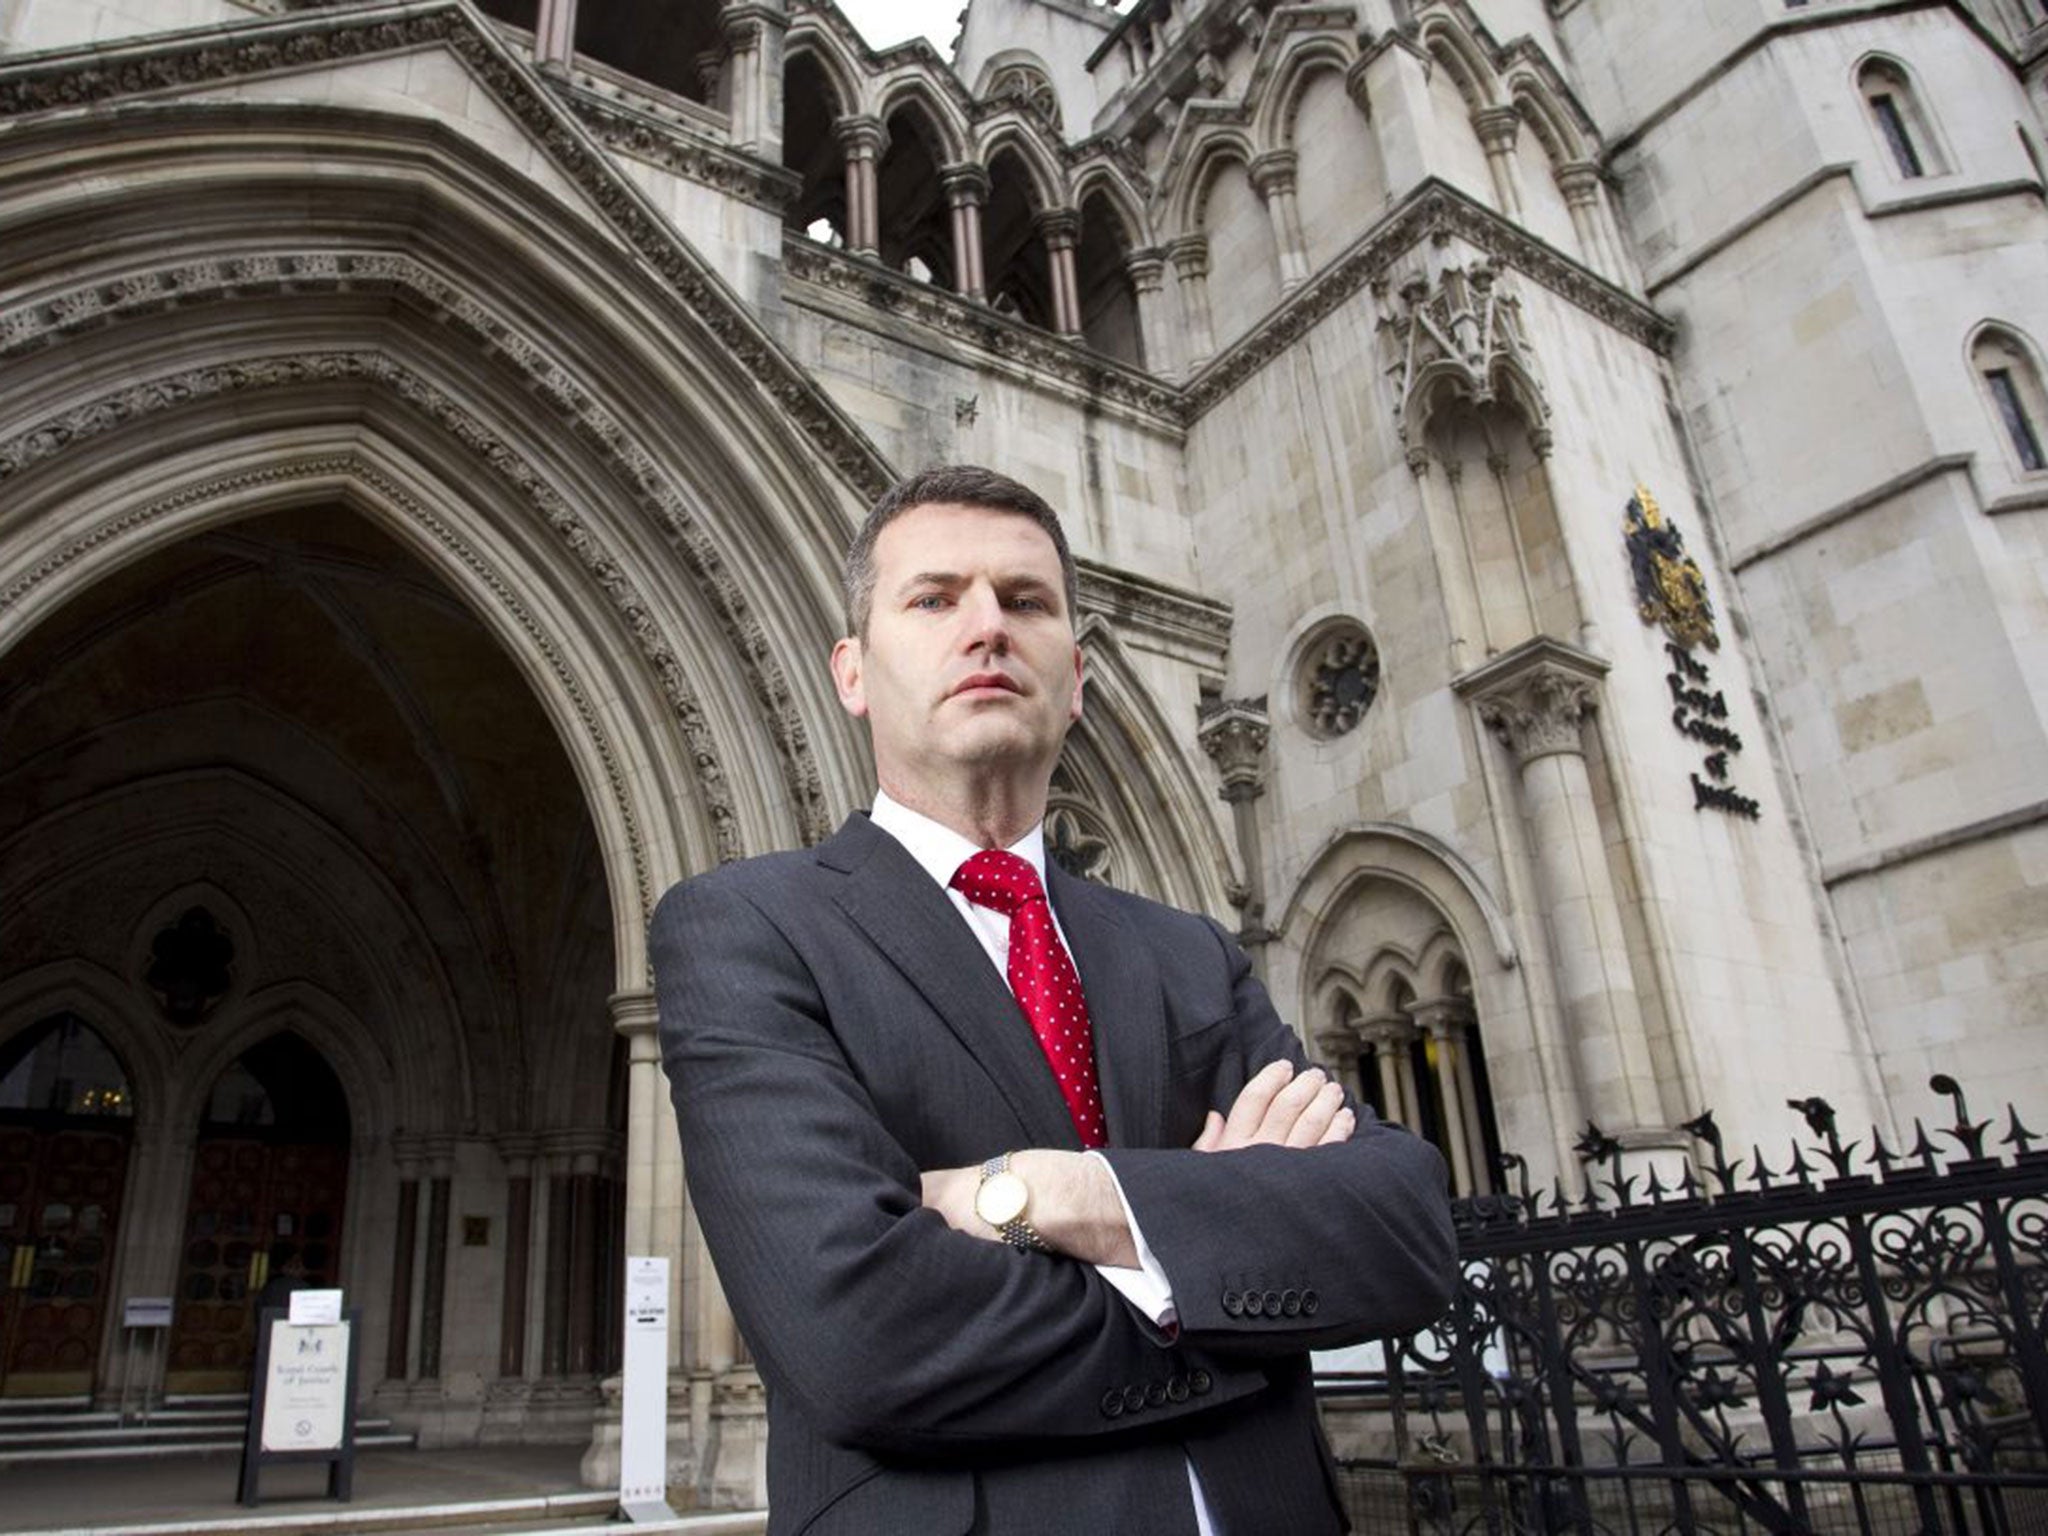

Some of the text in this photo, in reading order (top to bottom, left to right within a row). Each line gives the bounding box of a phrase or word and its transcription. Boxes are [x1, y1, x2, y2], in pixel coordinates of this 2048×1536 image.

[1665, 641, 1709, 684] The
[1666, 672, 1729, 719] Royal
[1672, 705, 1743, 753] Courts
[1704, 749, 1728, 782] of
[1690, 772, 1761, 823] Justice
